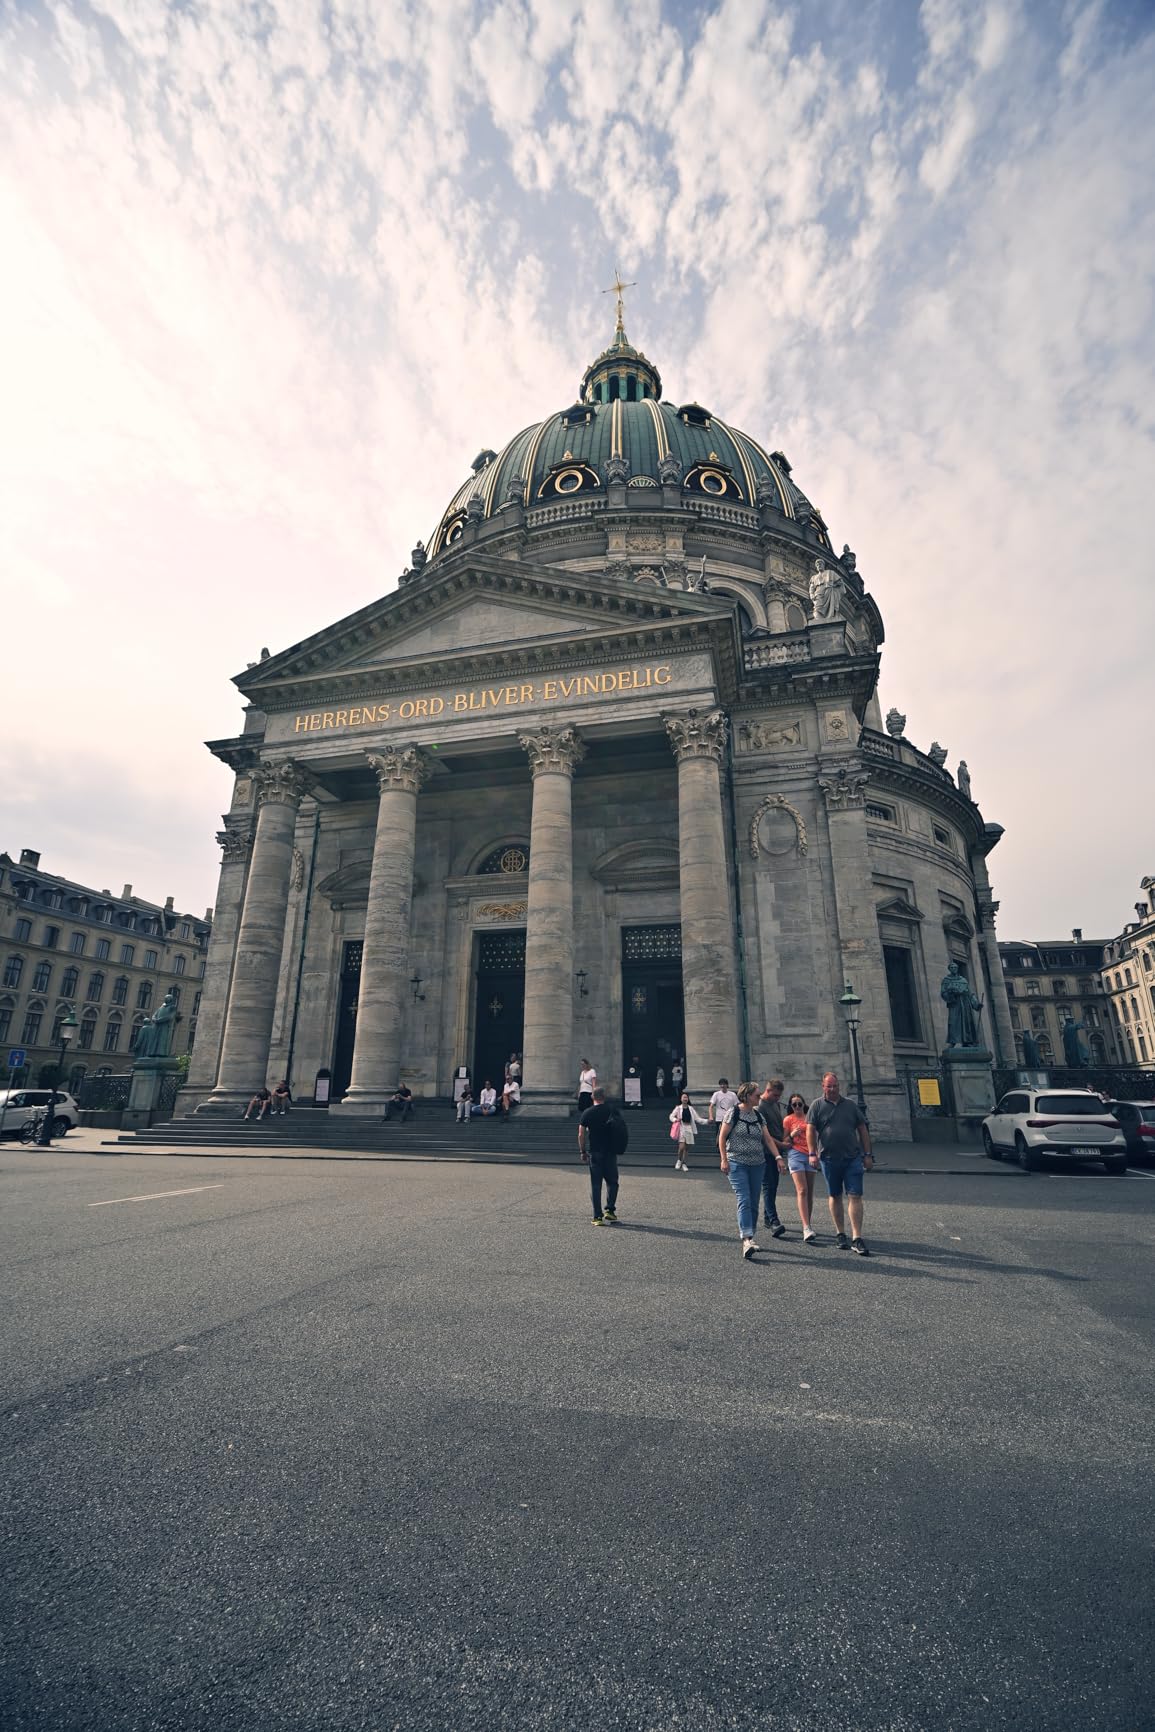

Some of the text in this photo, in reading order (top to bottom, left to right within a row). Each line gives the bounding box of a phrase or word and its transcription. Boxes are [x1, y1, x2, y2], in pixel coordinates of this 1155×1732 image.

[295, 666, 672, 733] HERRENS ORD BLIVER EVINDELIG
